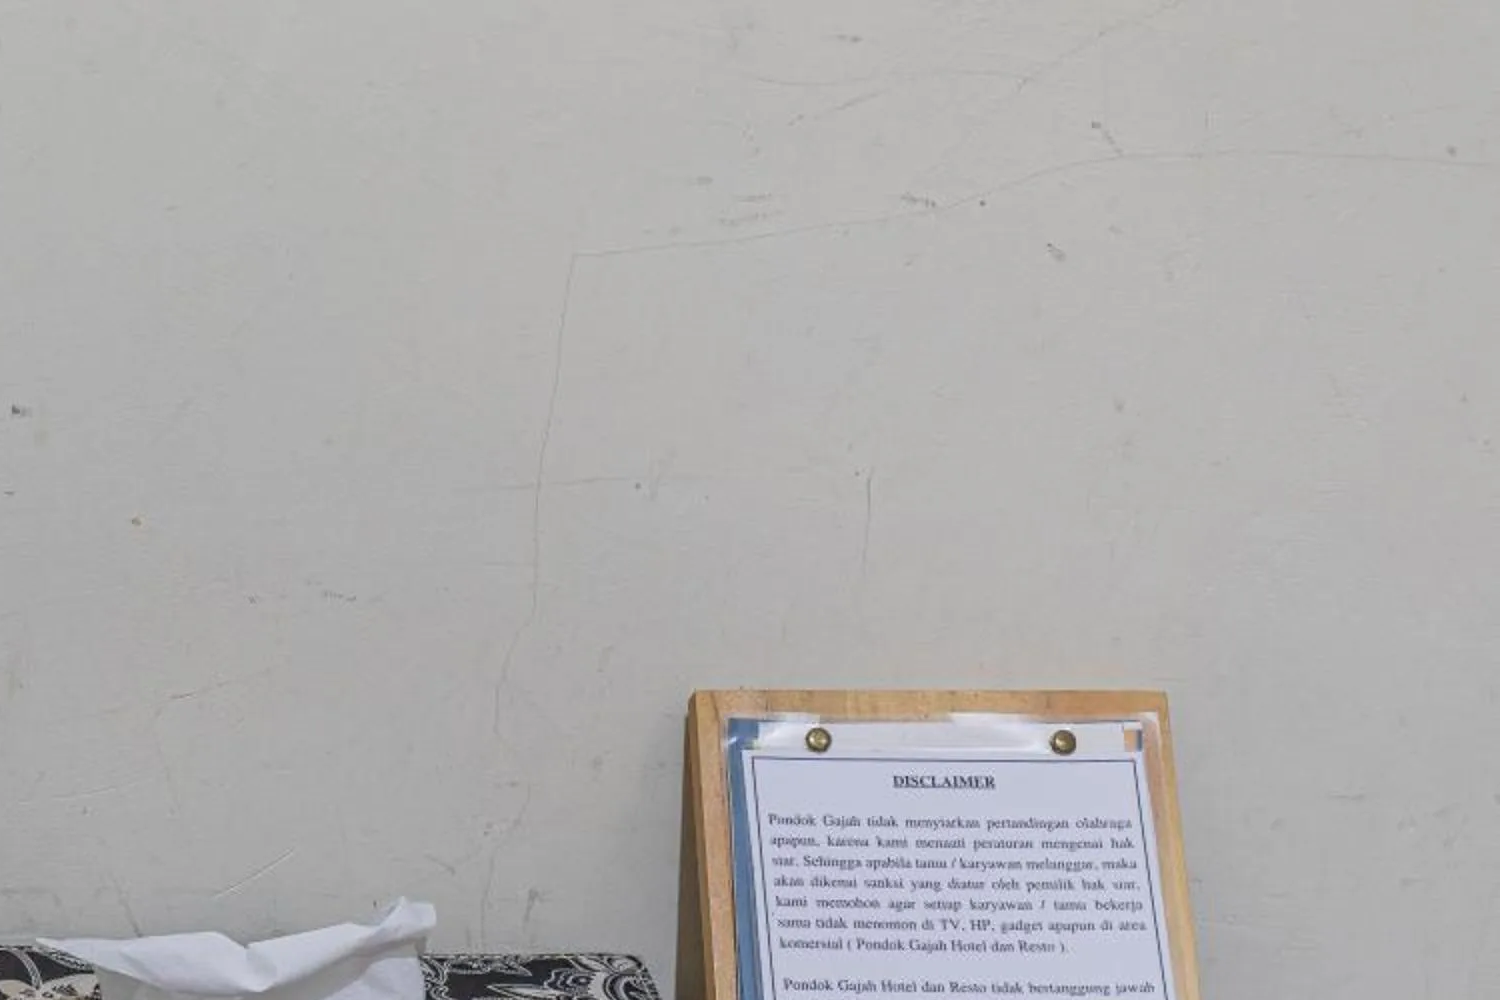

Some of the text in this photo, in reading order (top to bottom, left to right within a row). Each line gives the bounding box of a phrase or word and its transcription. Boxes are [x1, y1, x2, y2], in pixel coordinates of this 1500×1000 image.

[893, 775, 996, 788] DISCLAIMER
[768, 814, 816, 826] Pondok
[823, 815, 861, 828] Gajah
[867, 816, 898, 828] tidak
[905, 816, 980, 830] menyiarkan
[987, 816, 1069, 831] pertandingan
[827, 836, 870, 848] karena
[876, 836, 908, 848] kami
[973, 838, 1033, 850] peraturan
[1041, 838, 1103, 850] mengenai
[1110, 837, 1135, 849] hak
[803, 855, 862, 871] Sehingga
[865, 856, 912, 871] apabila
[915, 857, 948, 869] tamu
[959, 857, 1023, 872] karyawan
[1101, 858, 1137, 870] maka
[773, 876, 804, 887] akan
[864, 876, 904, 889] sanksi
[910, 878, 941, 892] yang
[992, 878, 1021, 890] oleh
[1027, 878, 1075, 893] pemilik
[1081, 878, 1106, 890] hak
[776, 895, 808, 908] kami
[816, 896, 882, 909] memohon
[888, 899, 917, 911] agar
[969, 898, 1033, 912] karyawan
[1053, 899, 1087, 910] tamu
[1095, 898, 1143, 913] bekerja
[816, 916, 849, 929] tidak
[922, 917, 935, 930] di
[1001, 919, 1044, 934] gadget
[1048, 920, 1096, 934] apapun
[1100, 919, 1113, 931] di
[856, 937, 905, 951] Pondok
[908, 937, 947, 953] Gajah
[951, 939, 987, 953] Hotel
[990, 939, 1014, 953] dan
[1018, 939, 1055, 953] Resto
[783, 979, 1155, 996] Pondok Gajah Hotel dan Resto tidak bertanggung jawab
